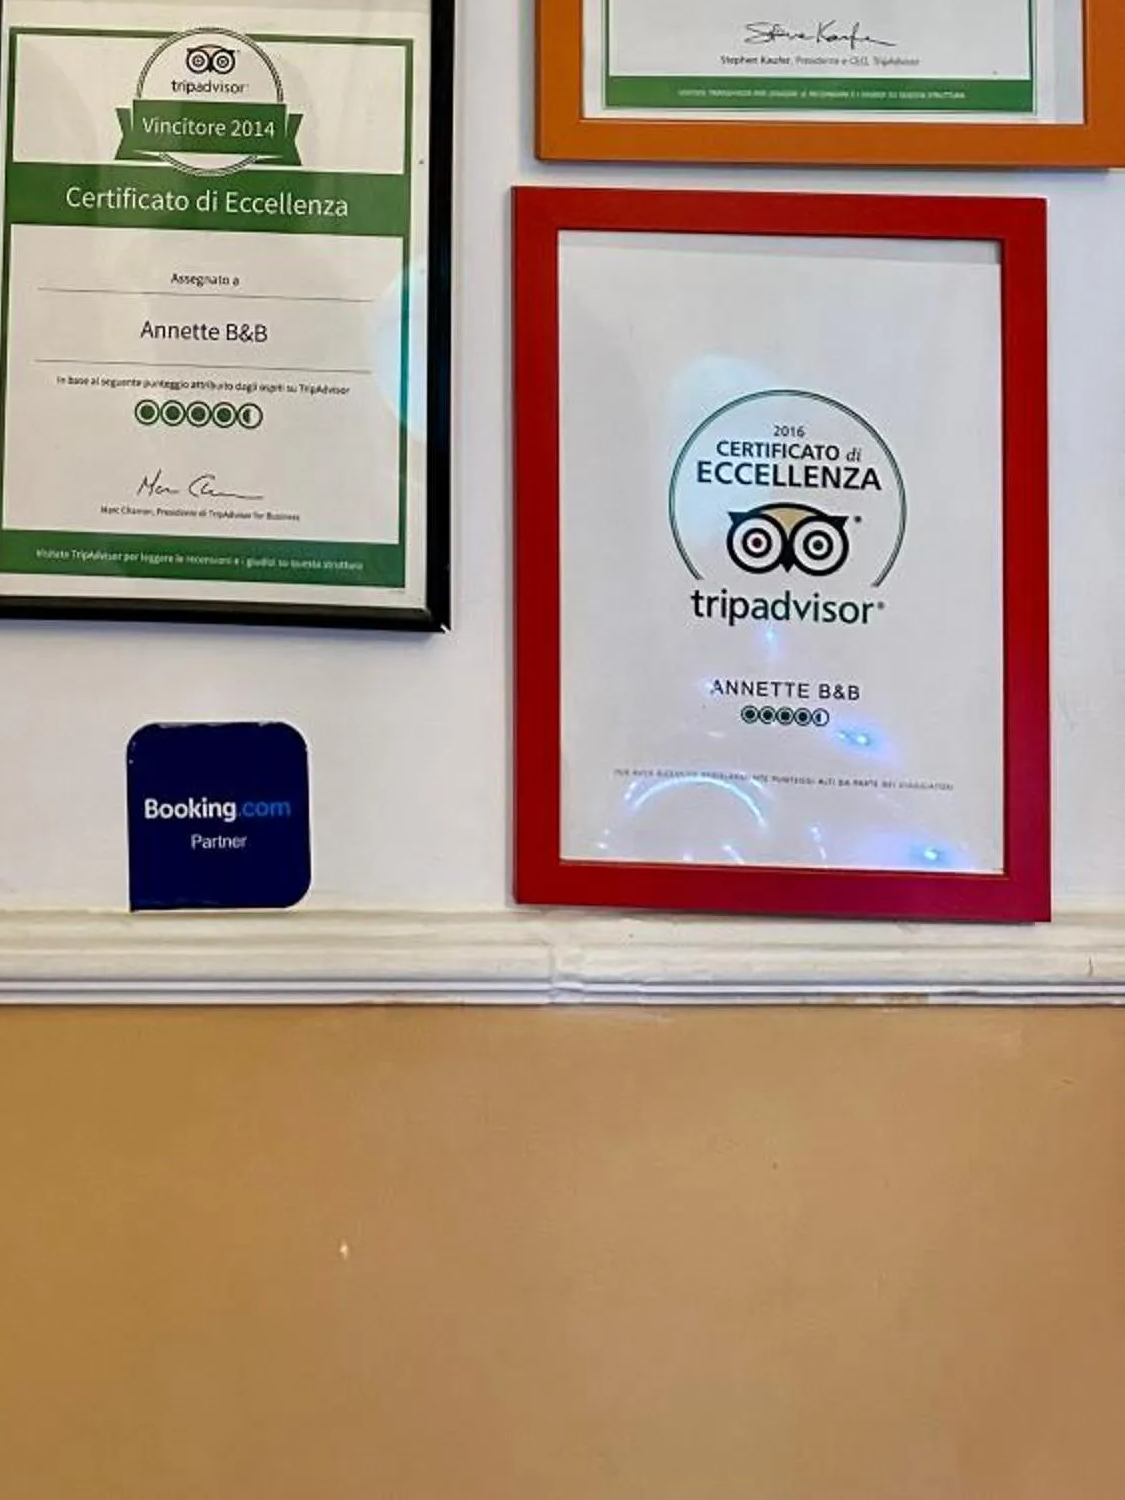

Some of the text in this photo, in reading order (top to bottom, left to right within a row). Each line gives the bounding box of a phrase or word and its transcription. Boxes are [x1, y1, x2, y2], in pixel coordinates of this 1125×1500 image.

[720, 55, 758, 66] Stephen
[171, 80, 245, 95] tripadvisor
[143, 117, 275, 138] Vincitore 2014
[66, 187, 348, 217] Certificato di Eccellenza
[171, 273, 240, 288] Assegnato a
[141, 321, 268, 343] Annette B&B
[68, 376, 89, 385] base
[773, 425, 805, 438] 2016
[716, 440, 862, 463] CERTIFICATO di
[697, 461, 882, 491] ECCELLENZA
[691, 589, 874, 626] tripadvisor
[710, 679, 860, 700] ANNETTE B&B
[144, 797, 291, 822] Booking.com
[191, 833, 247, 849] Partner
